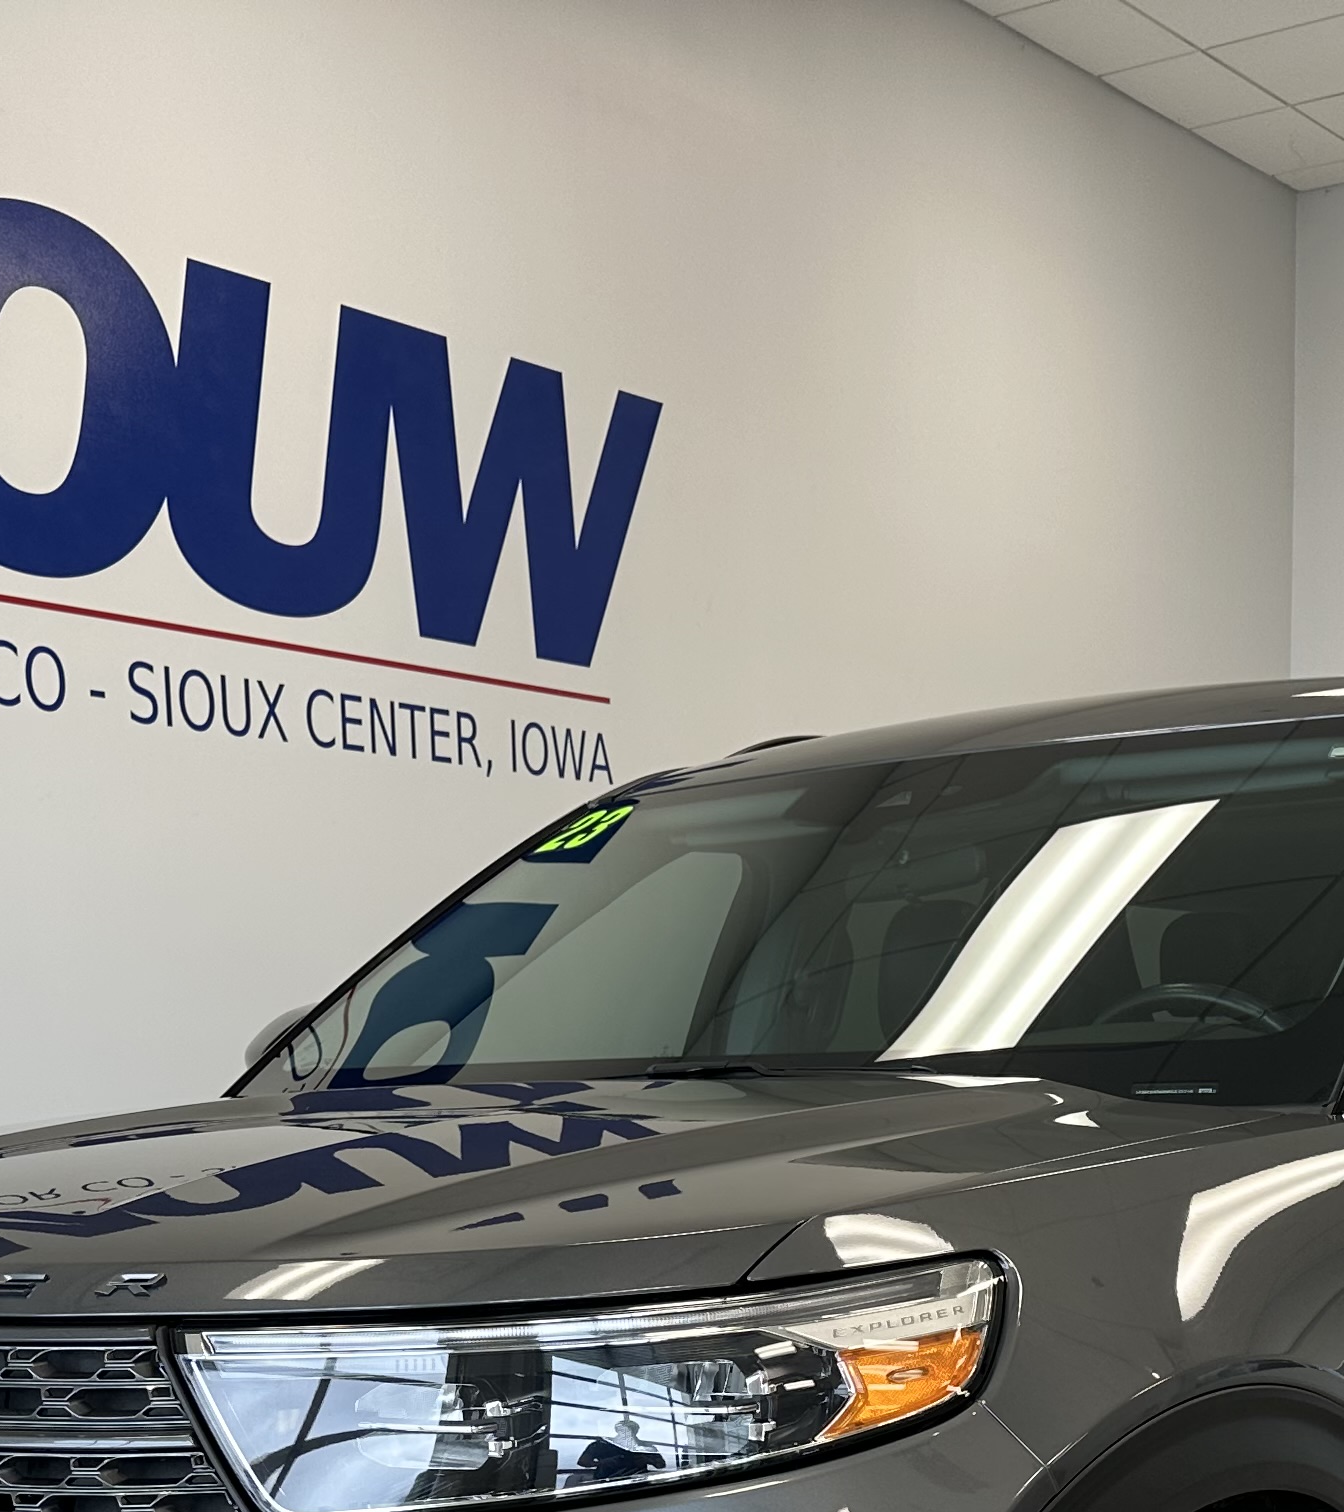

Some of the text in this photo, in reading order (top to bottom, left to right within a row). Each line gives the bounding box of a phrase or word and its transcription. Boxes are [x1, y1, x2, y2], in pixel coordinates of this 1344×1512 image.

[128, 660, 288, 743] SIOUX
[306, 688, 495, 777] CENTER,
[510, 719, 614, 785] IOWA
[534, 806, 633, 853] 23
[832, 1305, 966, 1338] EXPLORER
